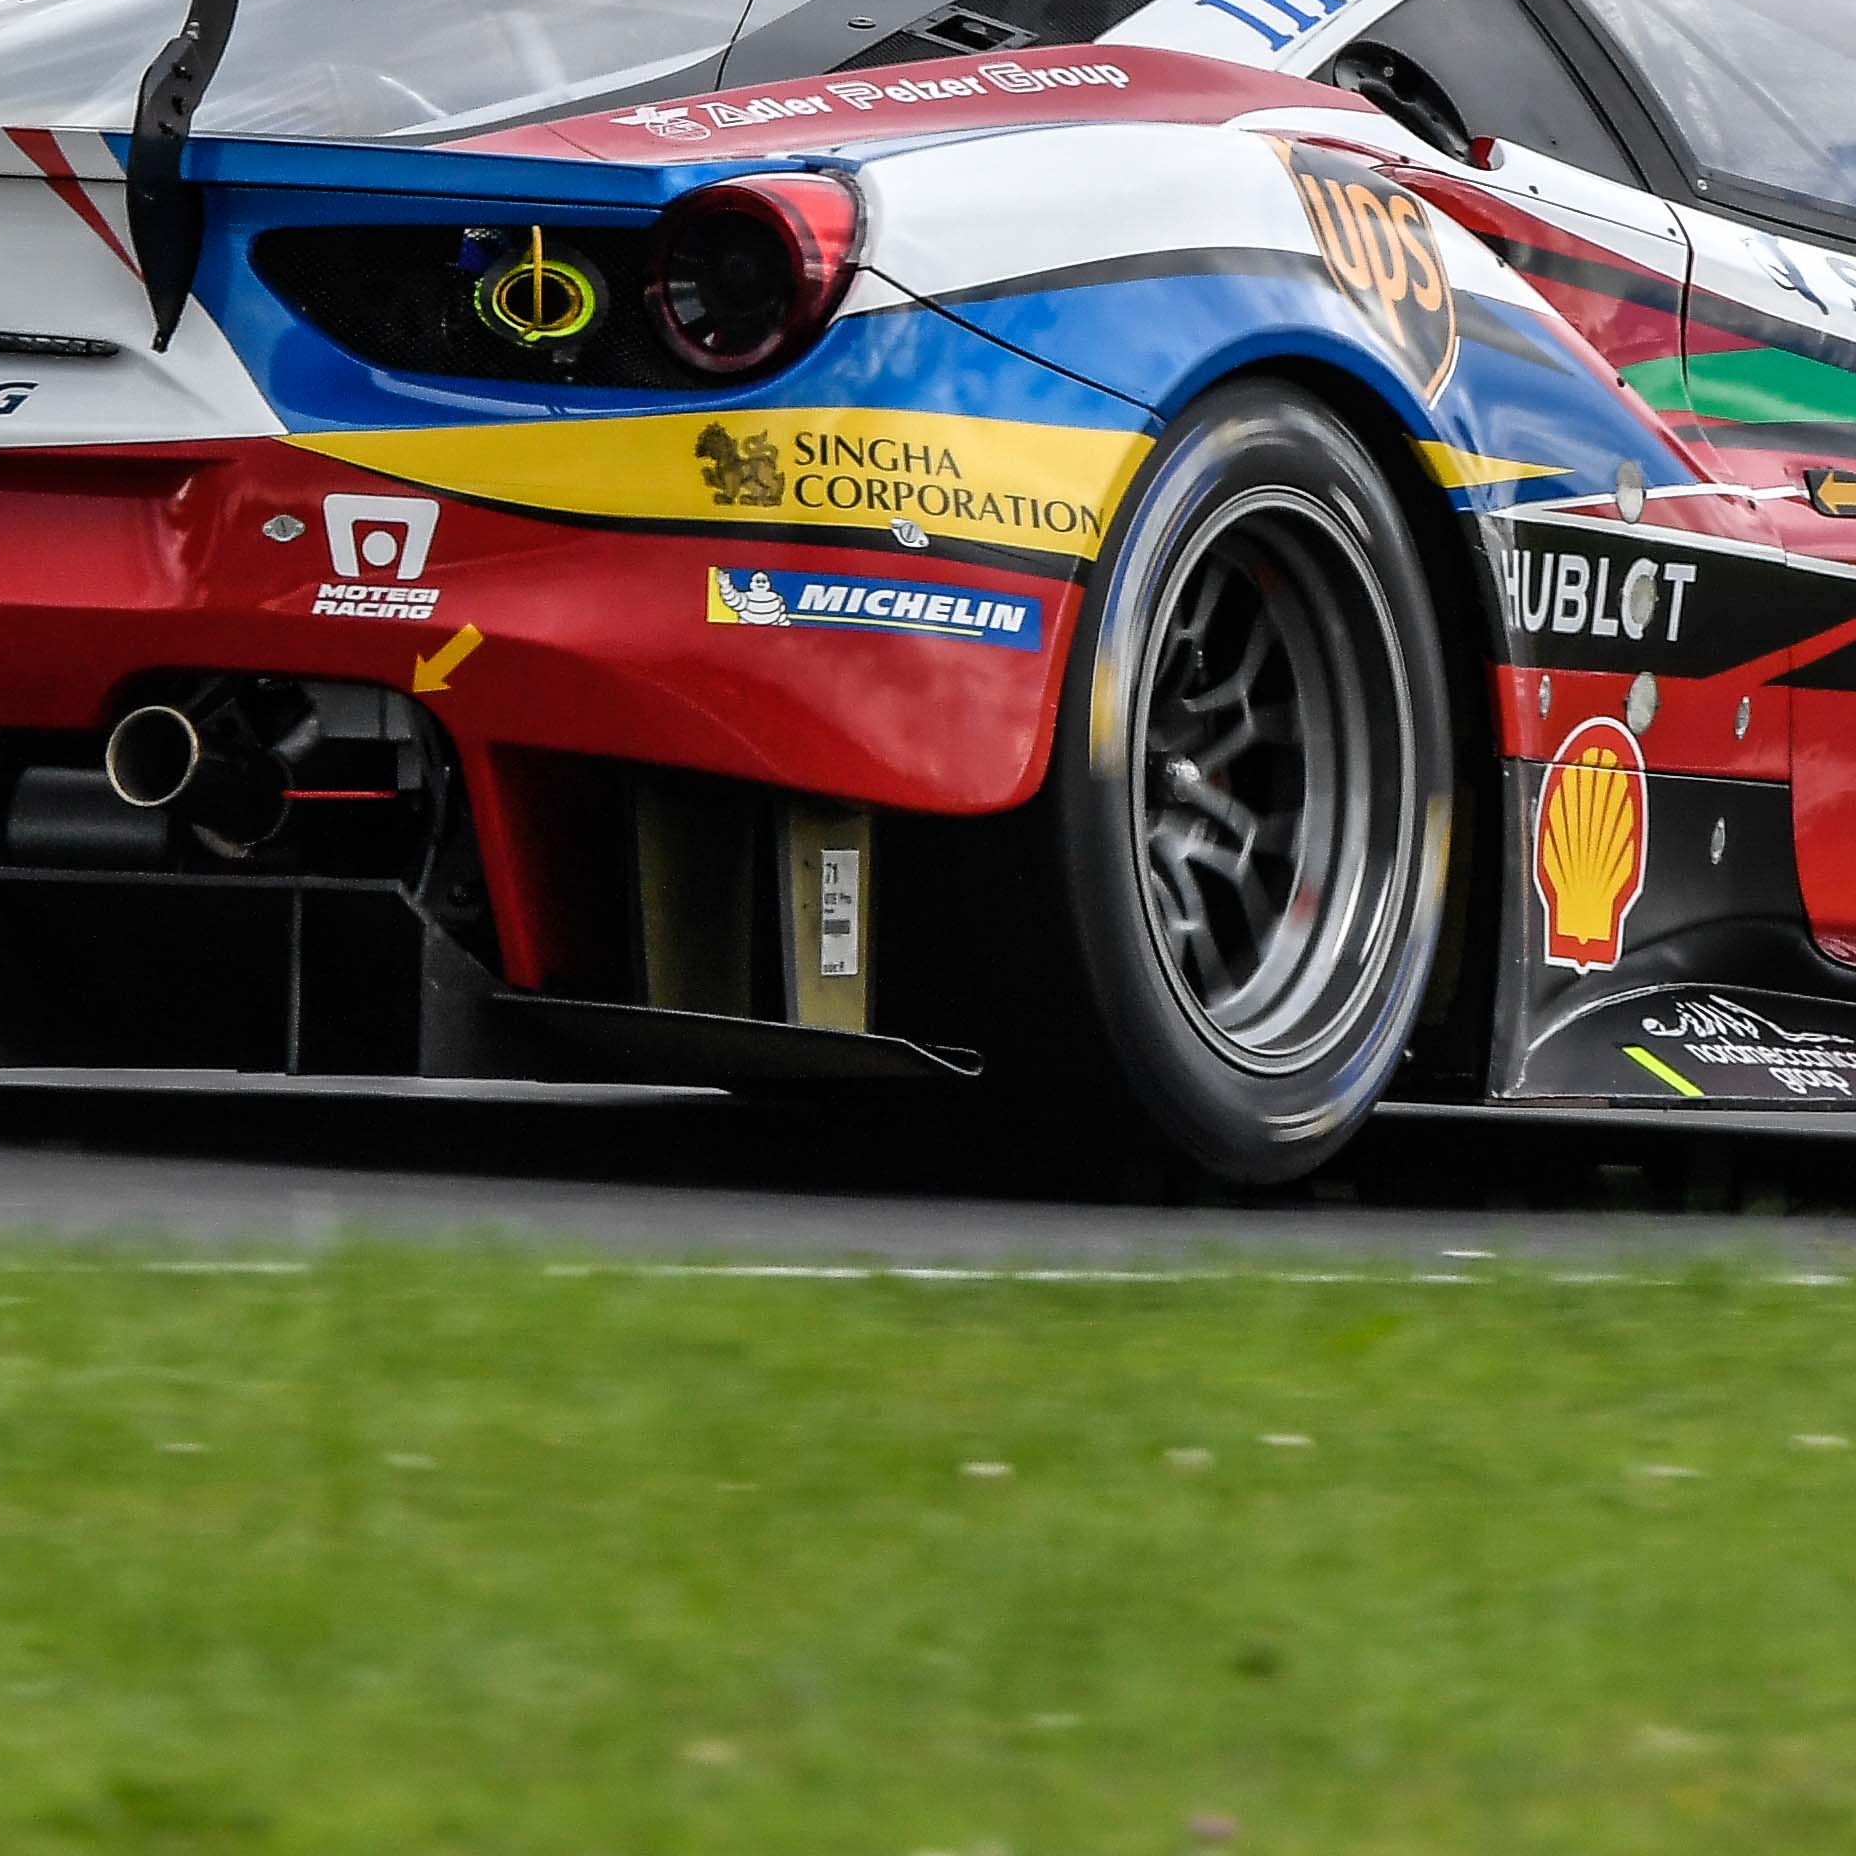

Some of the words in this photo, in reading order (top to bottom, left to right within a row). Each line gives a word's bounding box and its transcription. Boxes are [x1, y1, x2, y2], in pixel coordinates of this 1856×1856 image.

[697, 92, 831, 129] Adler
[828, 74, 988, 110] Pelzer
[979, 61, 1131, 93] Group
[794, 431, 962, 479] SINGHA
[794, 474, 1105, 539] CORPORATION
[312, 600, 434, 620] RACING
[317, 583, 440, 604] MOTEGI
[797, 584, 1027, 633] MICHELIN
